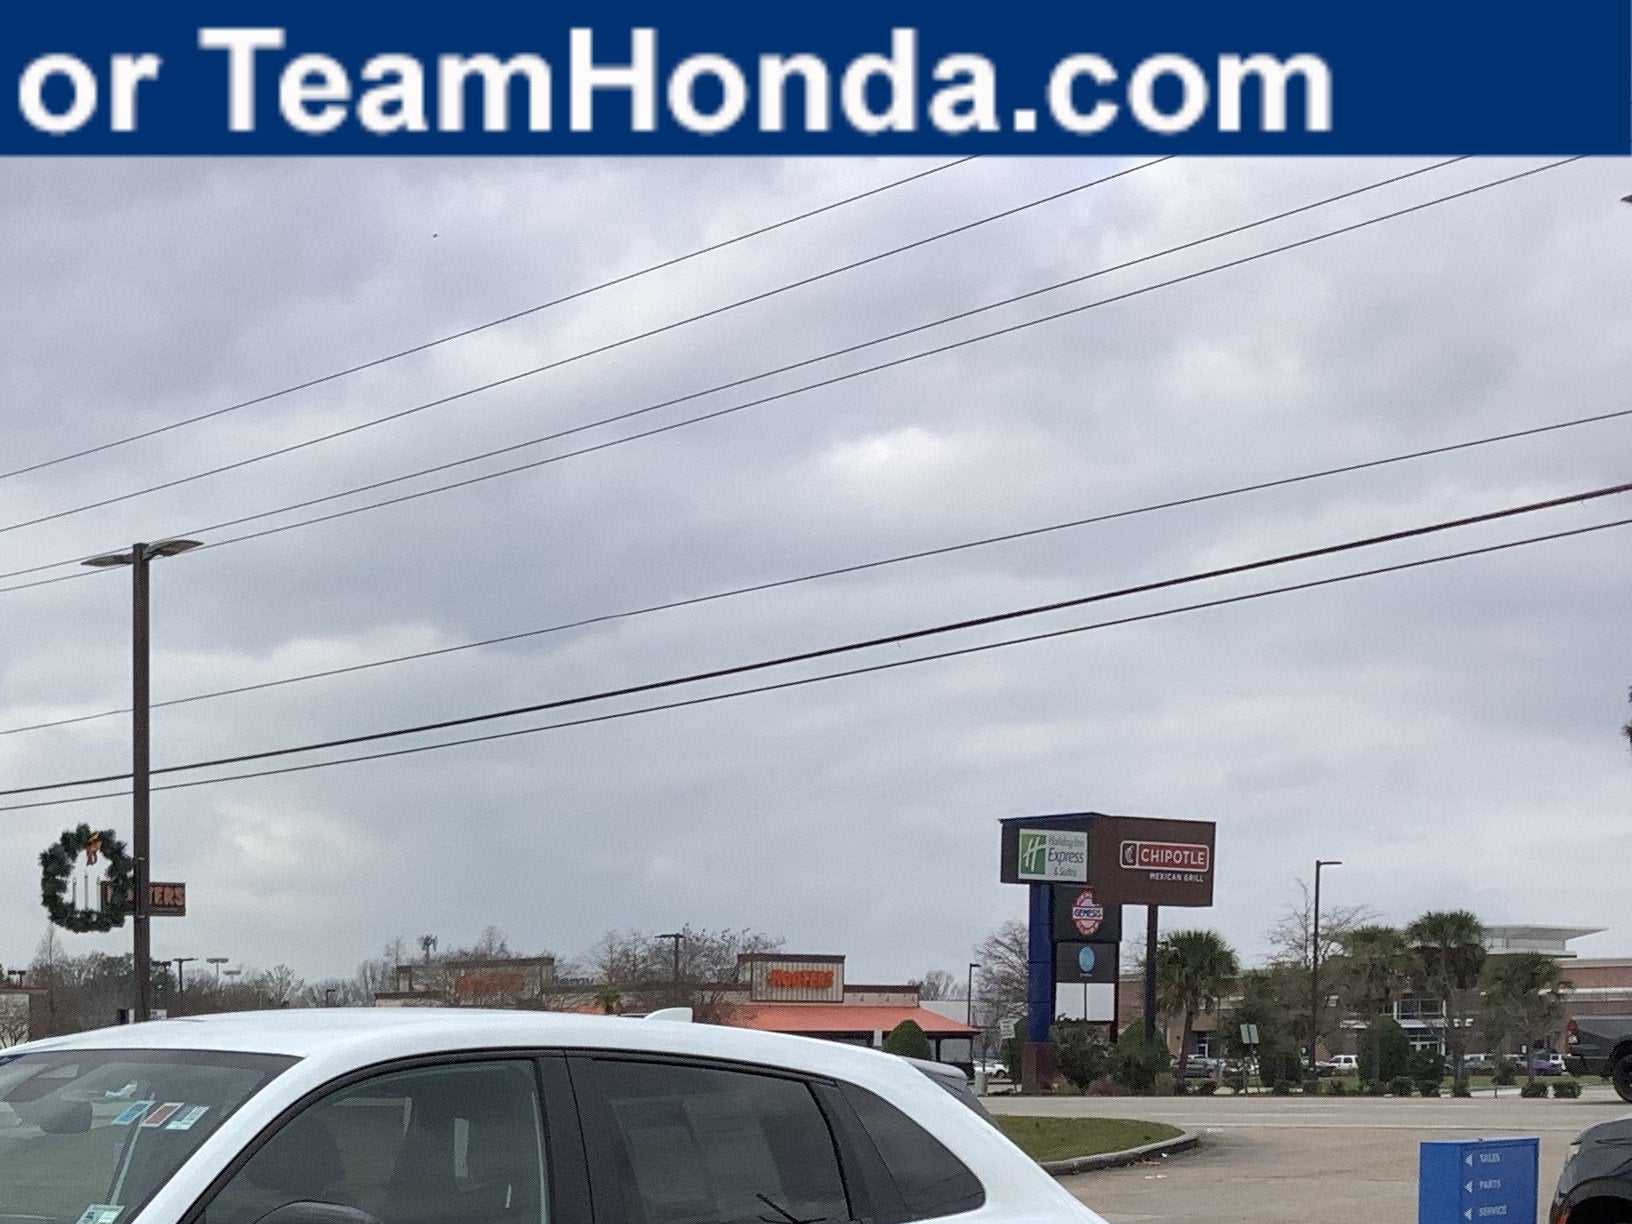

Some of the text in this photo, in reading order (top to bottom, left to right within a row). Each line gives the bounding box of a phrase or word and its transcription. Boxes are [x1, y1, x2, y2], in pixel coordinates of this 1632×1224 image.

[1048, 847, 1085, 865] Express
[1140, 848, 1206, 866] CHIPOTLE
[1149, 872, 1204, 883] MEXICAN GRILL
